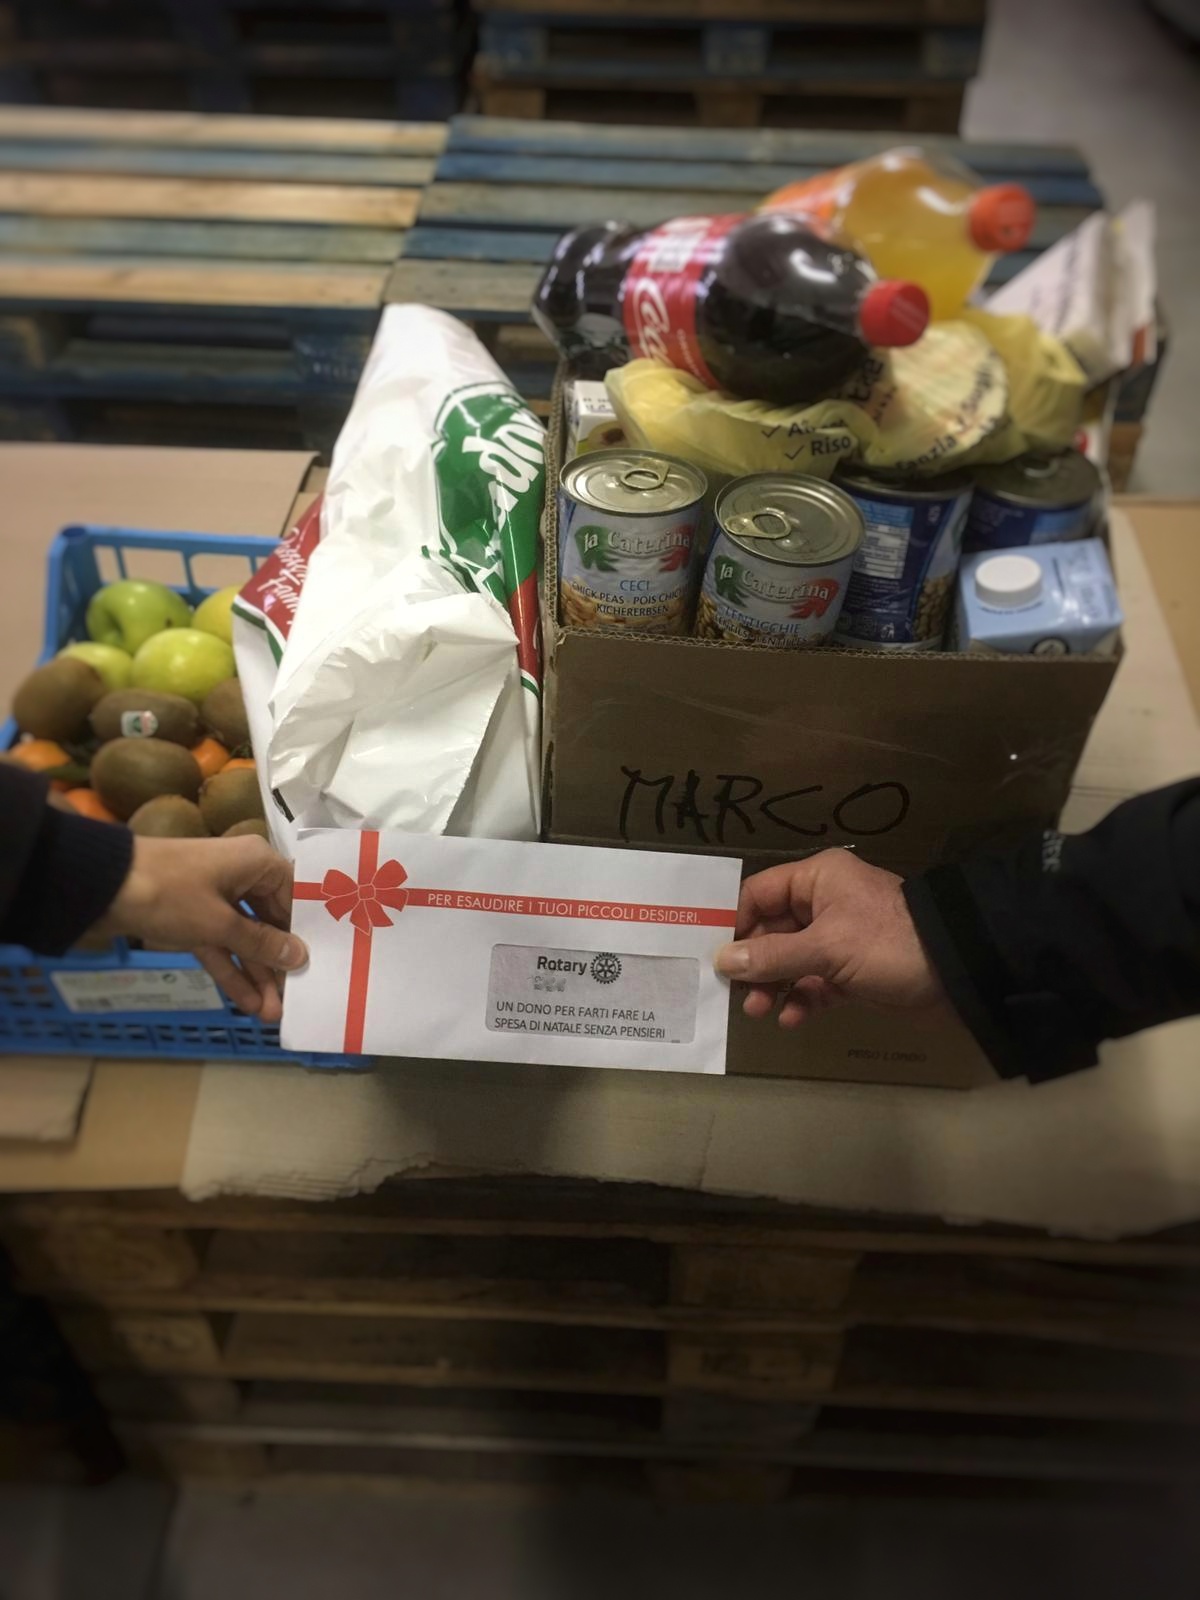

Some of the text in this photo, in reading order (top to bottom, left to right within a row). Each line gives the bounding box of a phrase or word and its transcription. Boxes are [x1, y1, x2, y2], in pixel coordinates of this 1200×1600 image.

[811, 435, 850, 457] Riso
[583, 530, 691, 555] la Caterina
[619, 579, 651, 592] CECI
[719, 562, 734, 580] la
[741, 568, 830, 600] Caterina
[599, 592, 625, 605] PEAS
[632, 594, 657, 605] POIS
[619, 765, 910, 844] MARCO
[427, 893, 452, 907] PER
[456, 895, 524, 913] ESAUDIRE
[537, 901, 573, 915] TUOI
[577, 904, 634, 920] PICCOLI
[638, 908, 702, 924] DESIDERI.
[536, 955, 587, 976] Rotary
[496, 1001, 656, 1022] UN DONO PER FARTI FARE LA
[494, 1017, 666, 1039] SPESA DI NATALE SENZA PENSIERI
